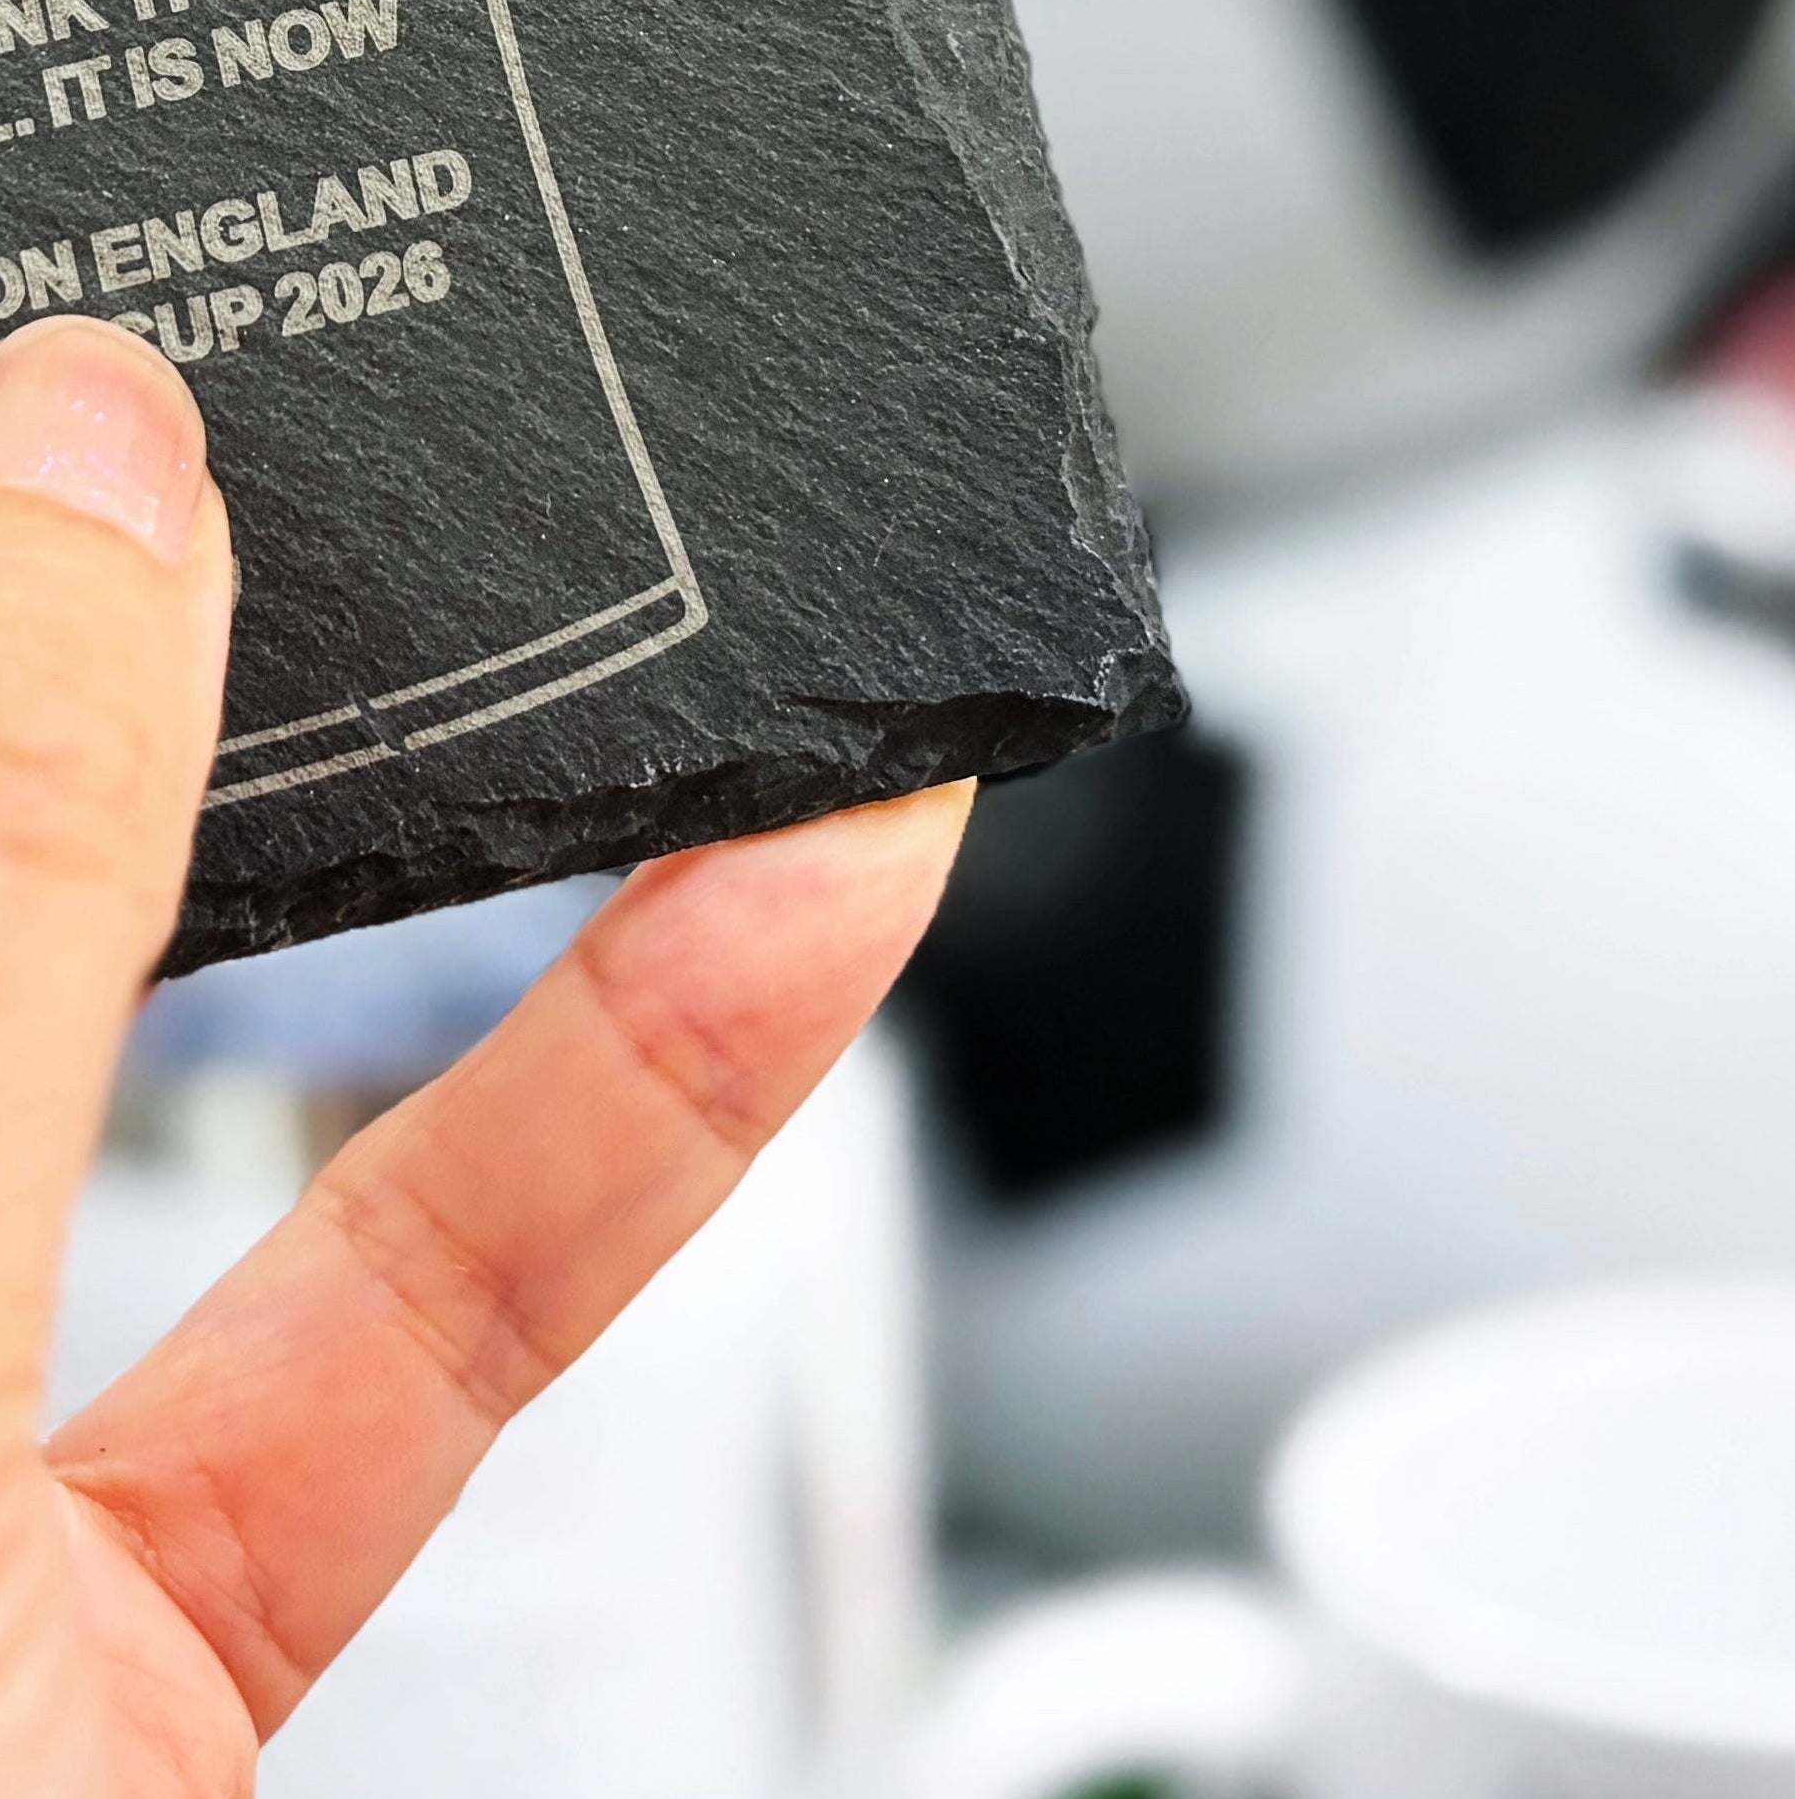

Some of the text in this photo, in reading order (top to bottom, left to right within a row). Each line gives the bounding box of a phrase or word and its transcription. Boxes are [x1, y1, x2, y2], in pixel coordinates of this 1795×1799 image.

[42, 56, 113, 128] IT
[127, 38, 205, 109] IS
[90, 150, 473, 293] ENGLAND
[274, 240, 452, 337] 2026
